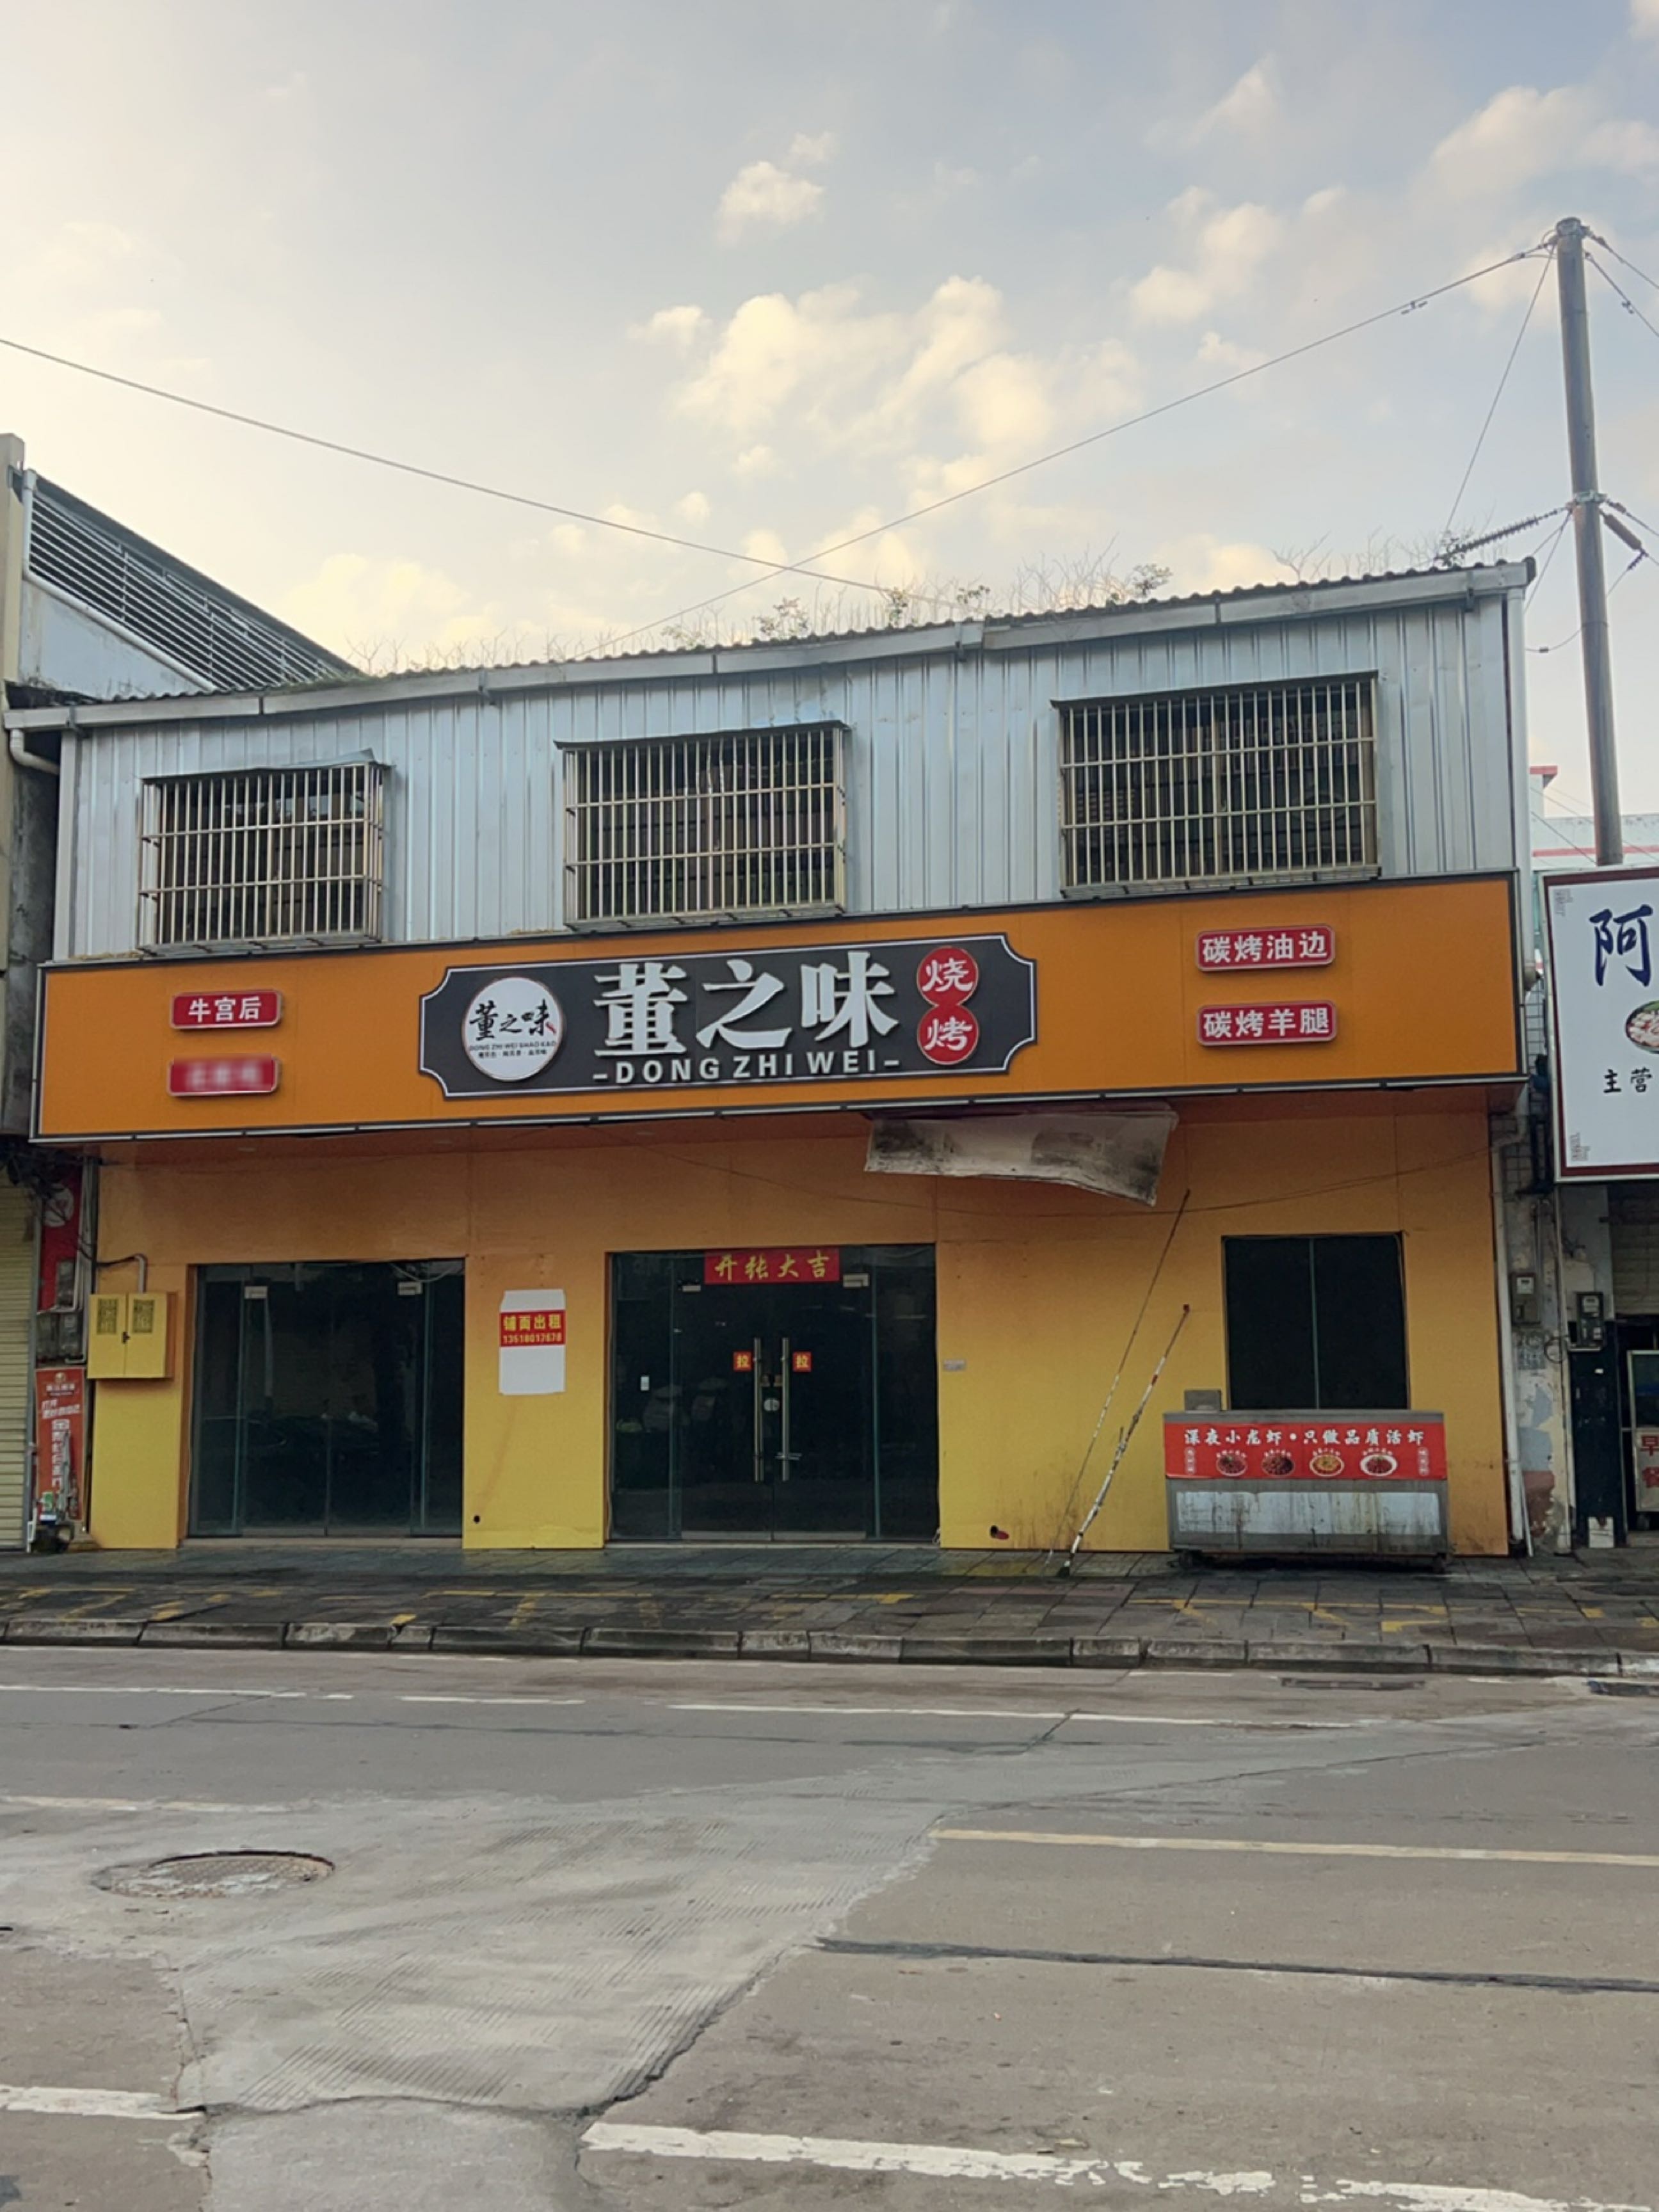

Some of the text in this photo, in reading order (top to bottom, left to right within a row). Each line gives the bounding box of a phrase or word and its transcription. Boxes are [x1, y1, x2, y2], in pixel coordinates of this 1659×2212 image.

[1203, 931, 1327, 963] 碳烤油边
[1589, 904, 1653, 986] 阿
[188, 996, 262, 1023] 牛宫后
[470, 998, 556, 1041] 董之味
[593, 950, 897, 1057] 董之味
[926, 958, 974, 1052] 烧烤
[1203, 1007, 1329, 1038] 碳烤羊腿
[733, 1054, 792, 1078] ZHI
[1604, 1067, 1653, 1093] 主营
[714, 1249, 830, 1281] 开张大吉
